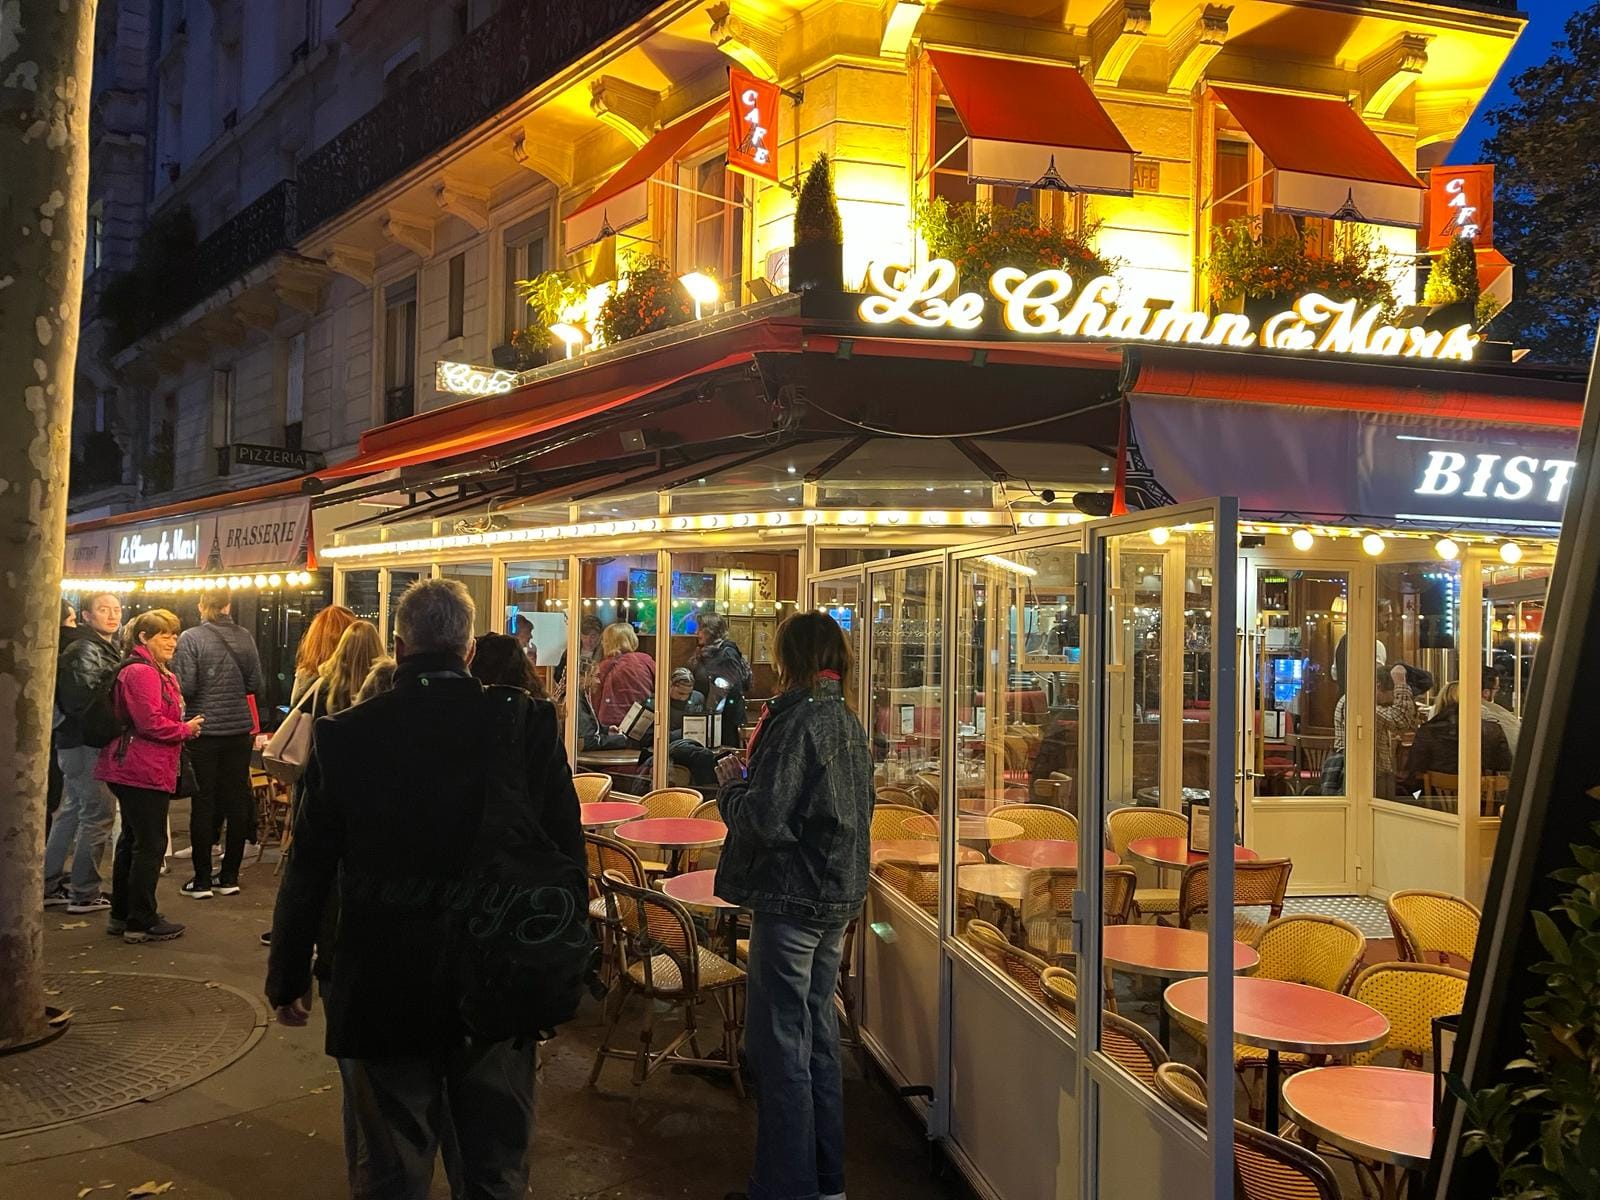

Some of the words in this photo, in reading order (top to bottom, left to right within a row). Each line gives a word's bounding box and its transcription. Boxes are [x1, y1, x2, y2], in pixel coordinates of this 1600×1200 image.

[741, 89, 769, 164] CAFE
[858, 258, 985, 330] Le
[239, 447, 304, 465] PIZZERIA
[119, 537, 129, 564] Le
[130, 534, 158, 569] Champ
[159, 531, 169, 560] de
[169, 528, 196, 560] Mars
[226, 521, 296, 548] BRASSERIE
